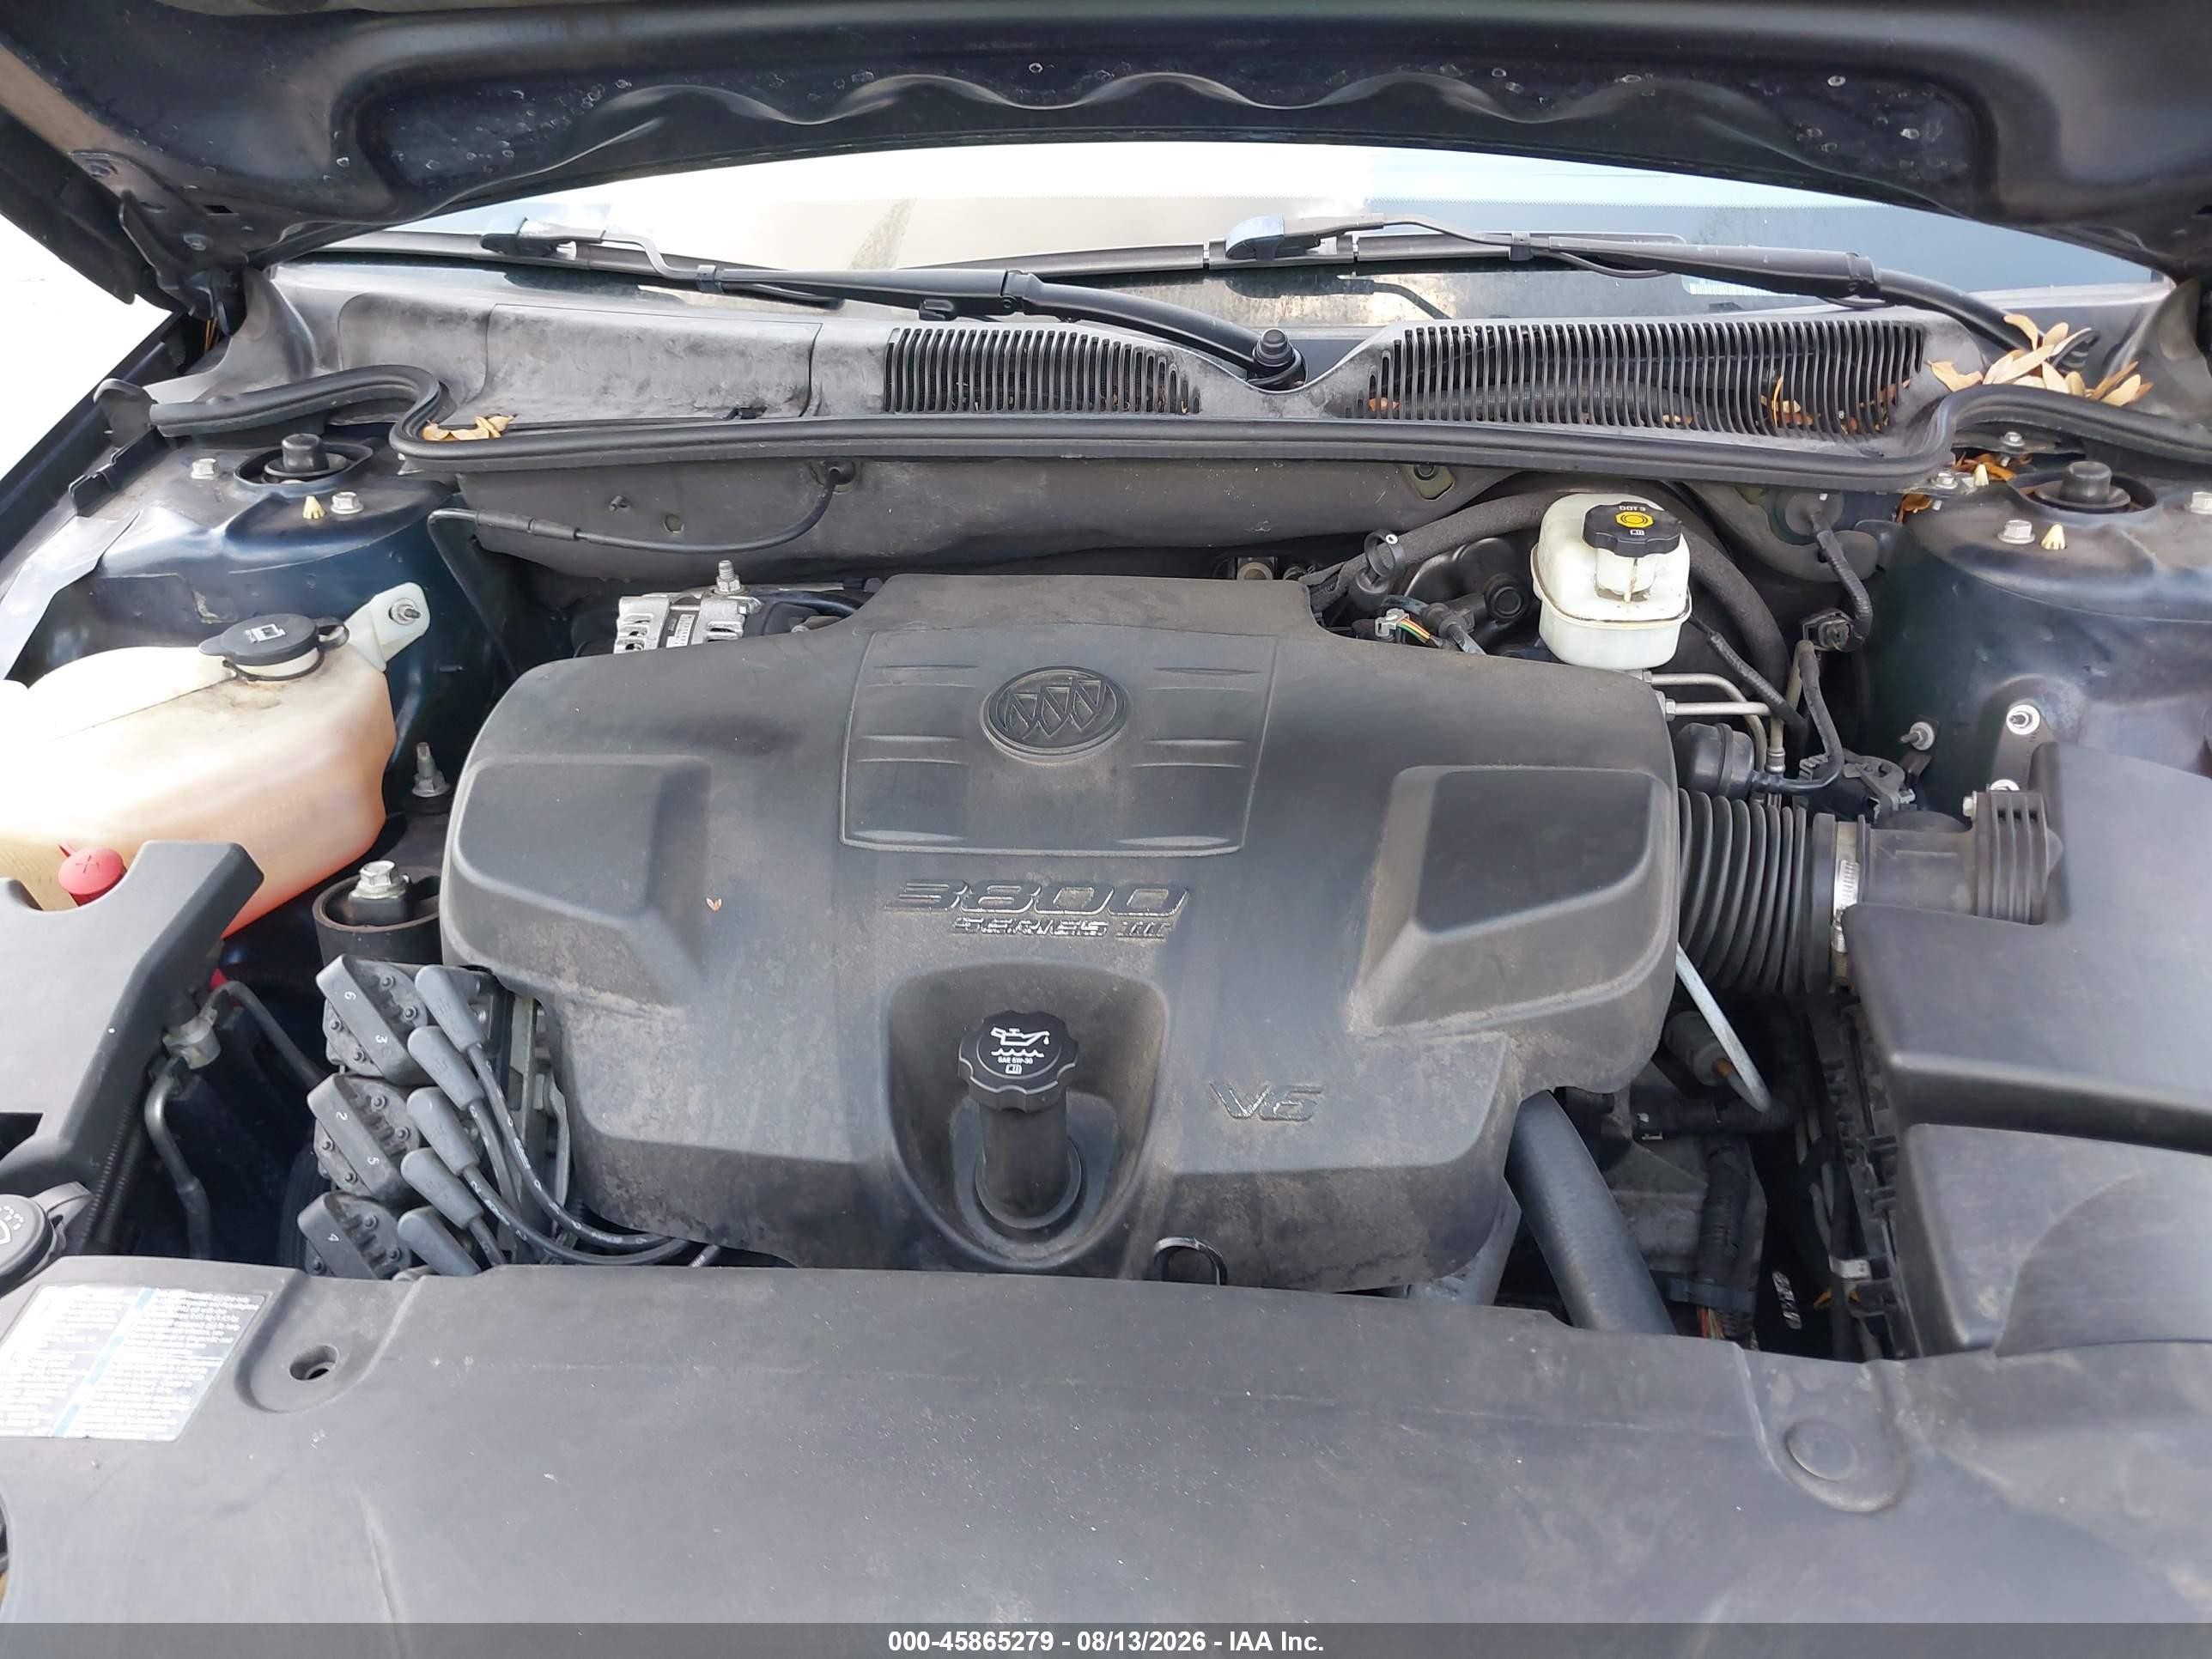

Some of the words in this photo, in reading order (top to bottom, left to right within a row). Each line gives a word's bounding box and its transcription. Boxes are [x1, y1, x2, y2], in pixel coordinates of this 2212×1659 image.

[885, 879, 1189, 918] 3800
[951, 916, 1109, 937] SERIES
[343, 990, 357, 1001] 6
[374, 1034, 389, 1044] 3
[1208, 1083, 1325, 1122] V6
[336, 1110, 349, 1121] 2
[367, 1156, 380, 1166] 5
